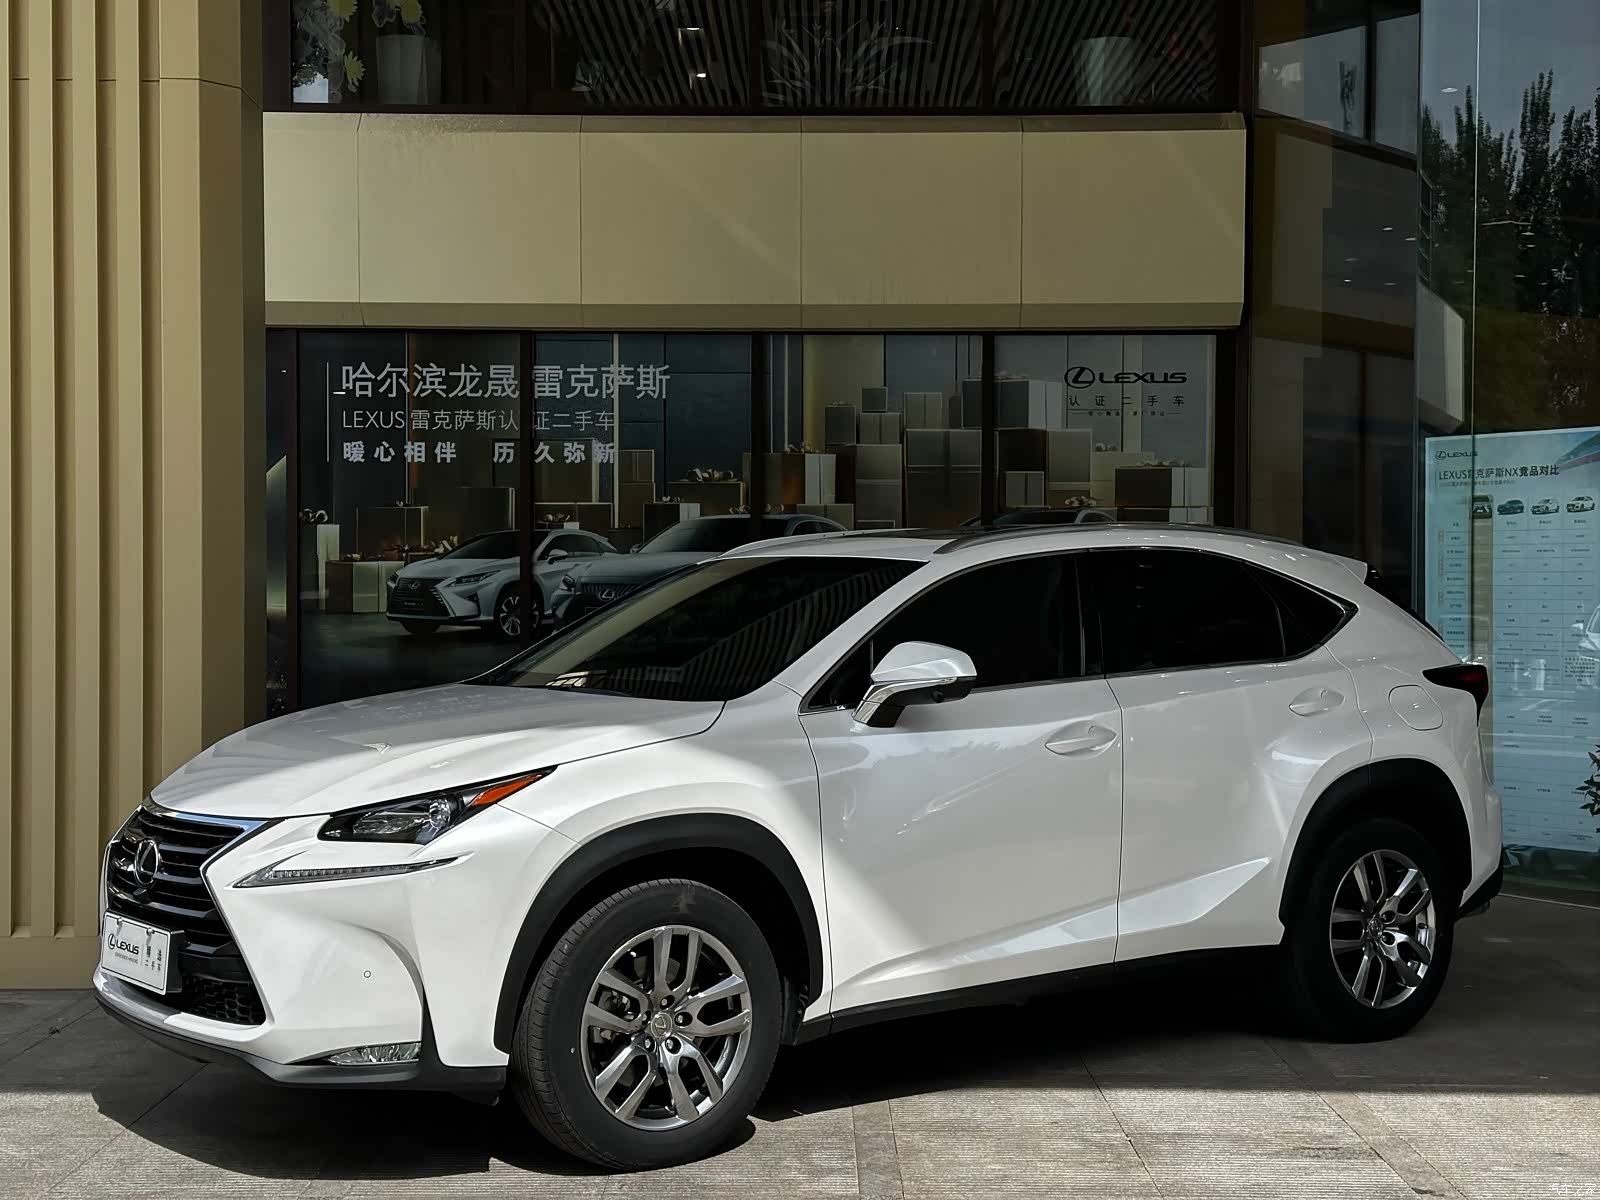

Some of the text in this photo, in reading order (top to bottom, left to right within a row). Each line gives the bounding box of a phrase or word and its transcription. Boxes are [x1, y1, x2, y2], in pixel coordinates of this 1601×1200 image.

[342, 362, 670, 399] 哈尔滨龙晟 雷克萨斯
[1099, 371, 1187, 383] LEXUS
[1069, 395, 1185, 407] 认证二手车
[343, 410, 405, 429] LEXUS
[343, 440, 615, 464] 暖心相伴 历久弥新
[115, 938, 140, 956] LEXUS
